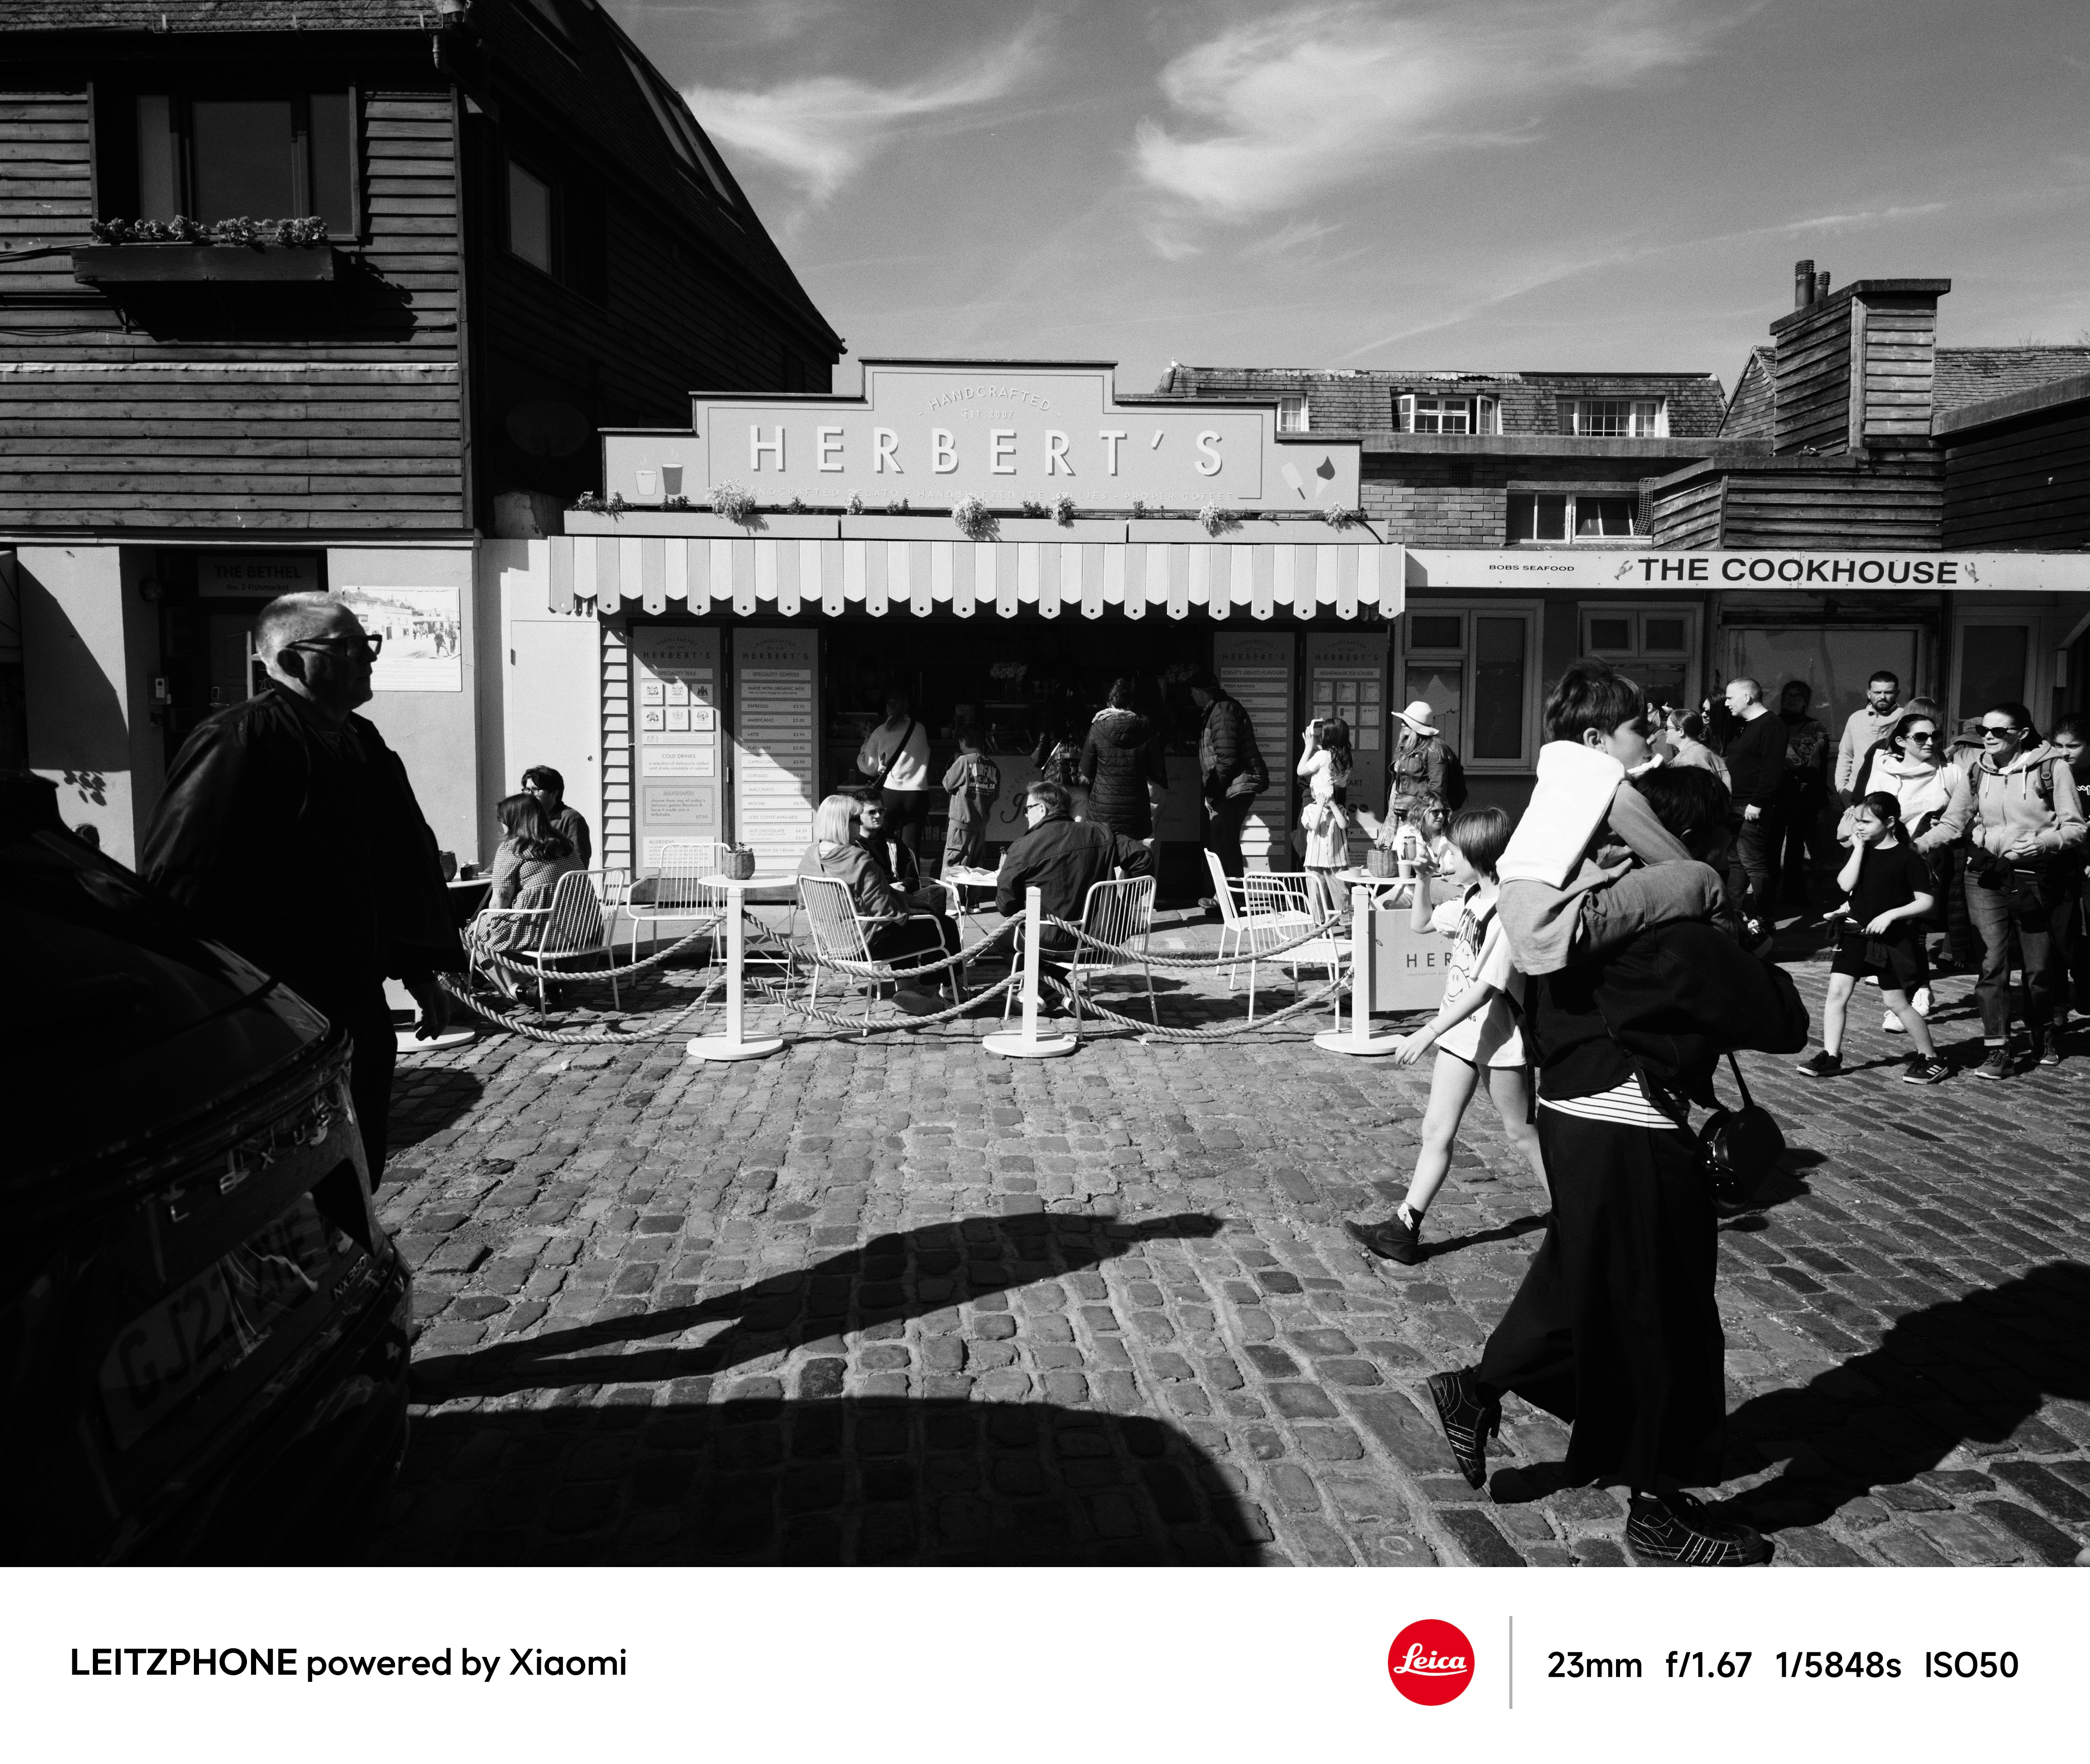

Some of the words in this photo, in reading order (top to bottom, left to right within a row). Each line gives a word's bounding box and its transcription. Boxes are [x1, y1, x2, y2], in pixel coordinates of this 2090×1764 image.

[928, 386, 1050, 411] HANDCRAFTED
[989, 411, 1014, 419] 2007
[751, 425, 1223, 476] HERBERT'S
[1125, 492, 1175, 501] PROPER
[1182, 493, 1234, 501] COFFEE
[214, 565, 243, 578] THE
[247, 565, 302, 579] BETHEL
[1638, 559, 1709, 582] THE
[1722, 559, 1958, 585] COOKHOUSE
[170, 1112, 331, 1223] LEXUS
